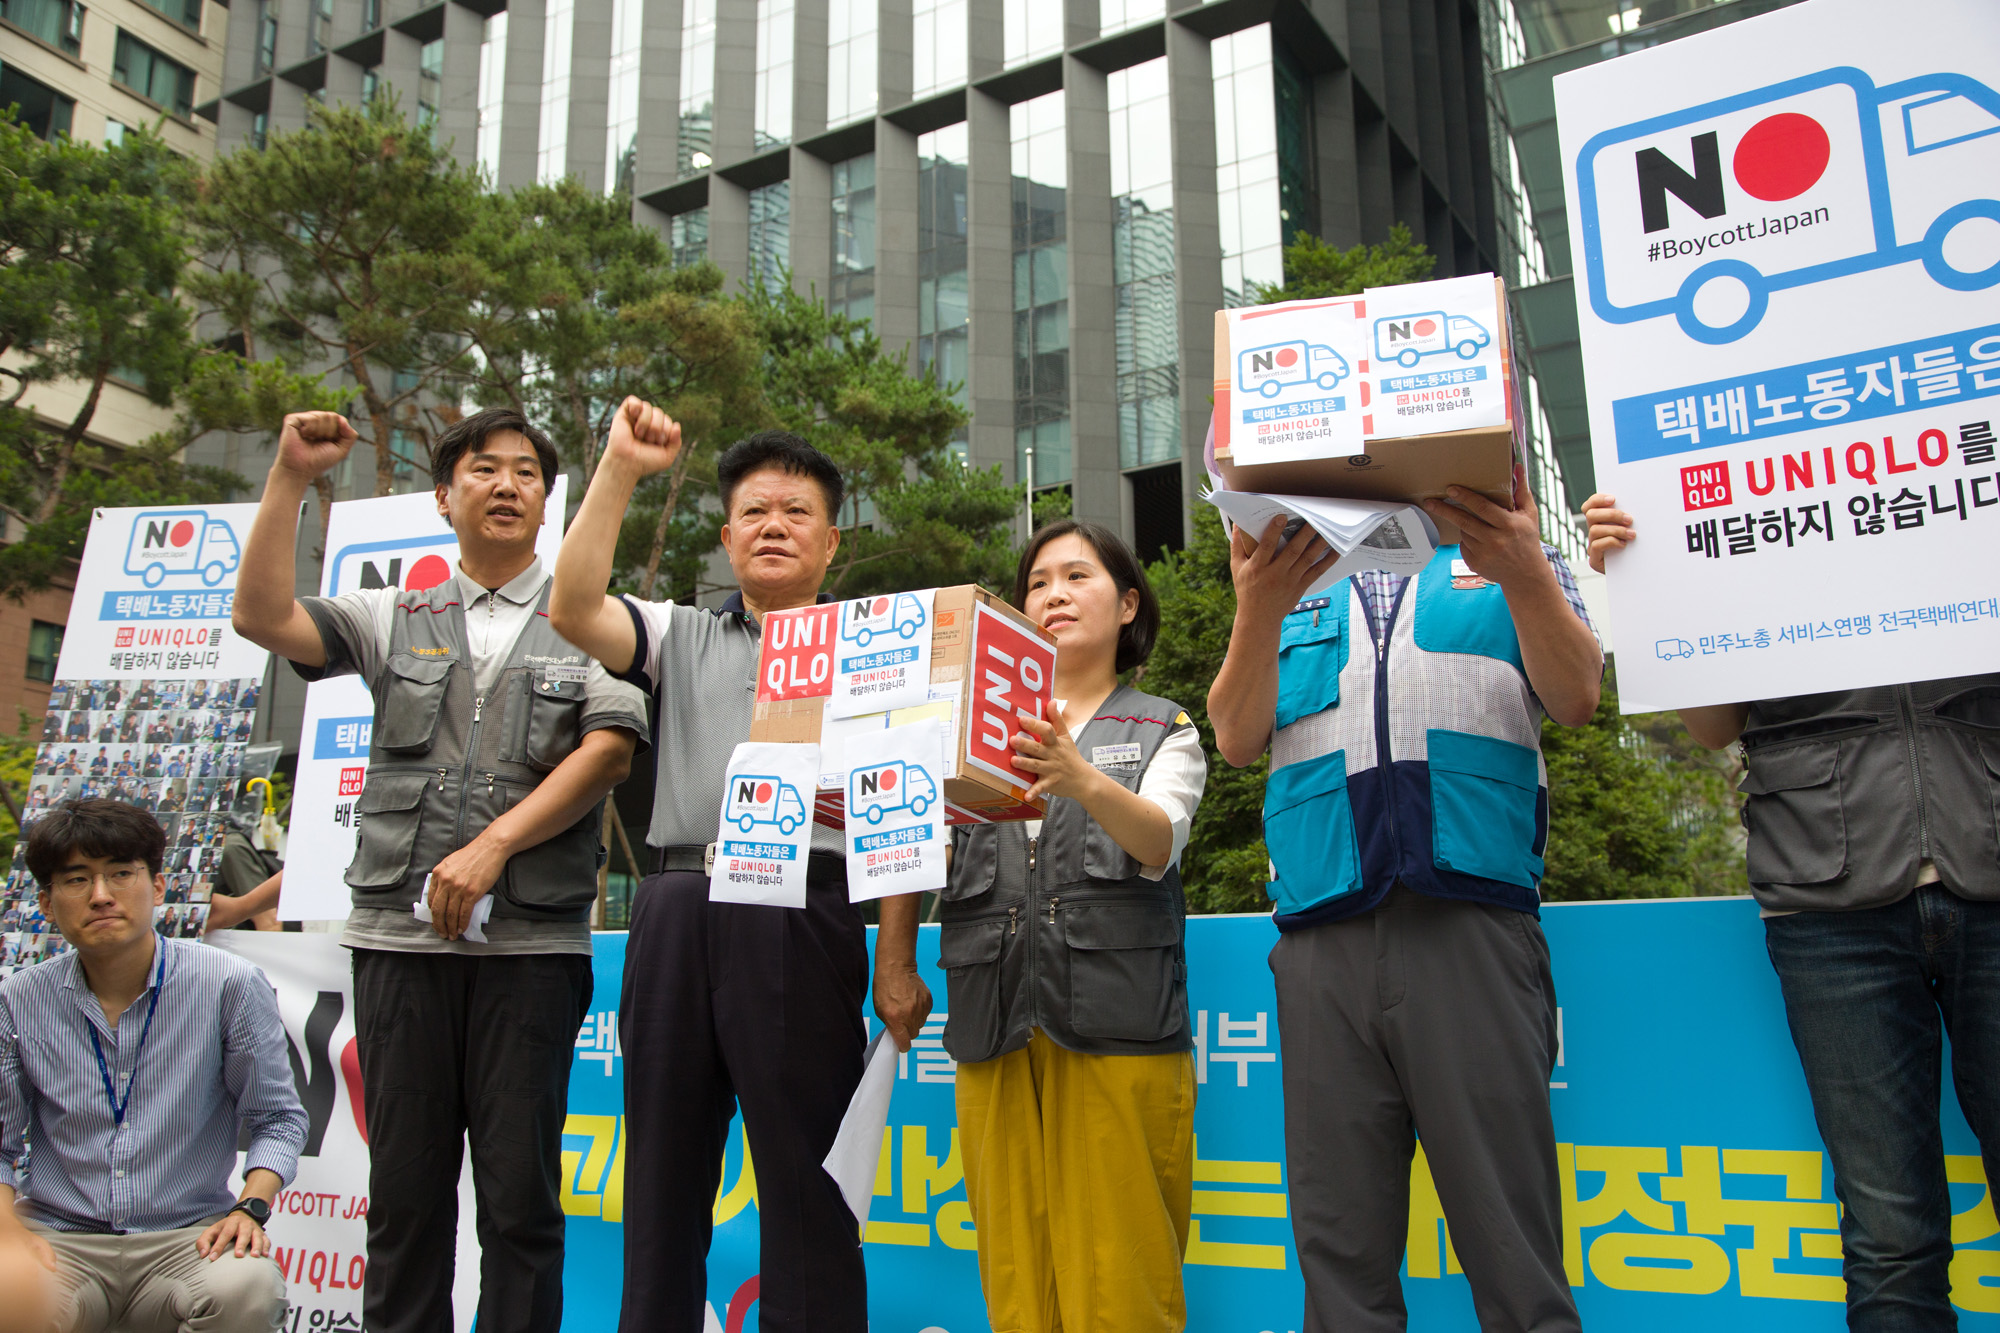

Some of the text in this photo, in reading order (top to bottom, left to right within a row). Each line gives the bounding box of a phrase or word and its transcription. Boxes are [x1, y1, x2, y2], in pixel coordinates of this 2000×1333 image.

[1647, 206, 1830, 263] #BoycottJapan
[1390, 369, 1477, 391] 택배노동자들은
[1654, 335, 2000, 444] 택배노동자들은
[1252, 399, 1336, 421] 택배노동자들은
[1397, 398, 1474, 416] 배달하지 않습니다
[1257, 428, 1332, 445] 배달하지 않습니다
[1685, 466, 1722, 487] UNI
[1687, 486, 1727, 507] QLO
[1685, 471, 2000, 559] 배달하지 않습니다
[771, 613, 829, 651] UNI
[1698, 597, 2000, 655] 민주노총 서비스연맹 전국택배연대
[109, 651, 219, 670] 배달하지 않습니다
[848, 649, 912, 671] 택배노동자들은
[767, 652, 830, 695] QLO
[850, 679, 906, 696] 배달하지 않습니다
[342, 770, 362, 782] UNI
[341, 782, 361, 794] QLO
[861, 827, 926, 850] 택배노동자들은
[730, 843, 790, 859] 택배노동자들은
[729, 872, 783, 886] 배달하지 않습니다
[867, 859, 922, 877] 배달하지 않습니다
[270, 1190, 341, 1218] YCOTT
[275, 1246, 366, 1294] NIQLO
